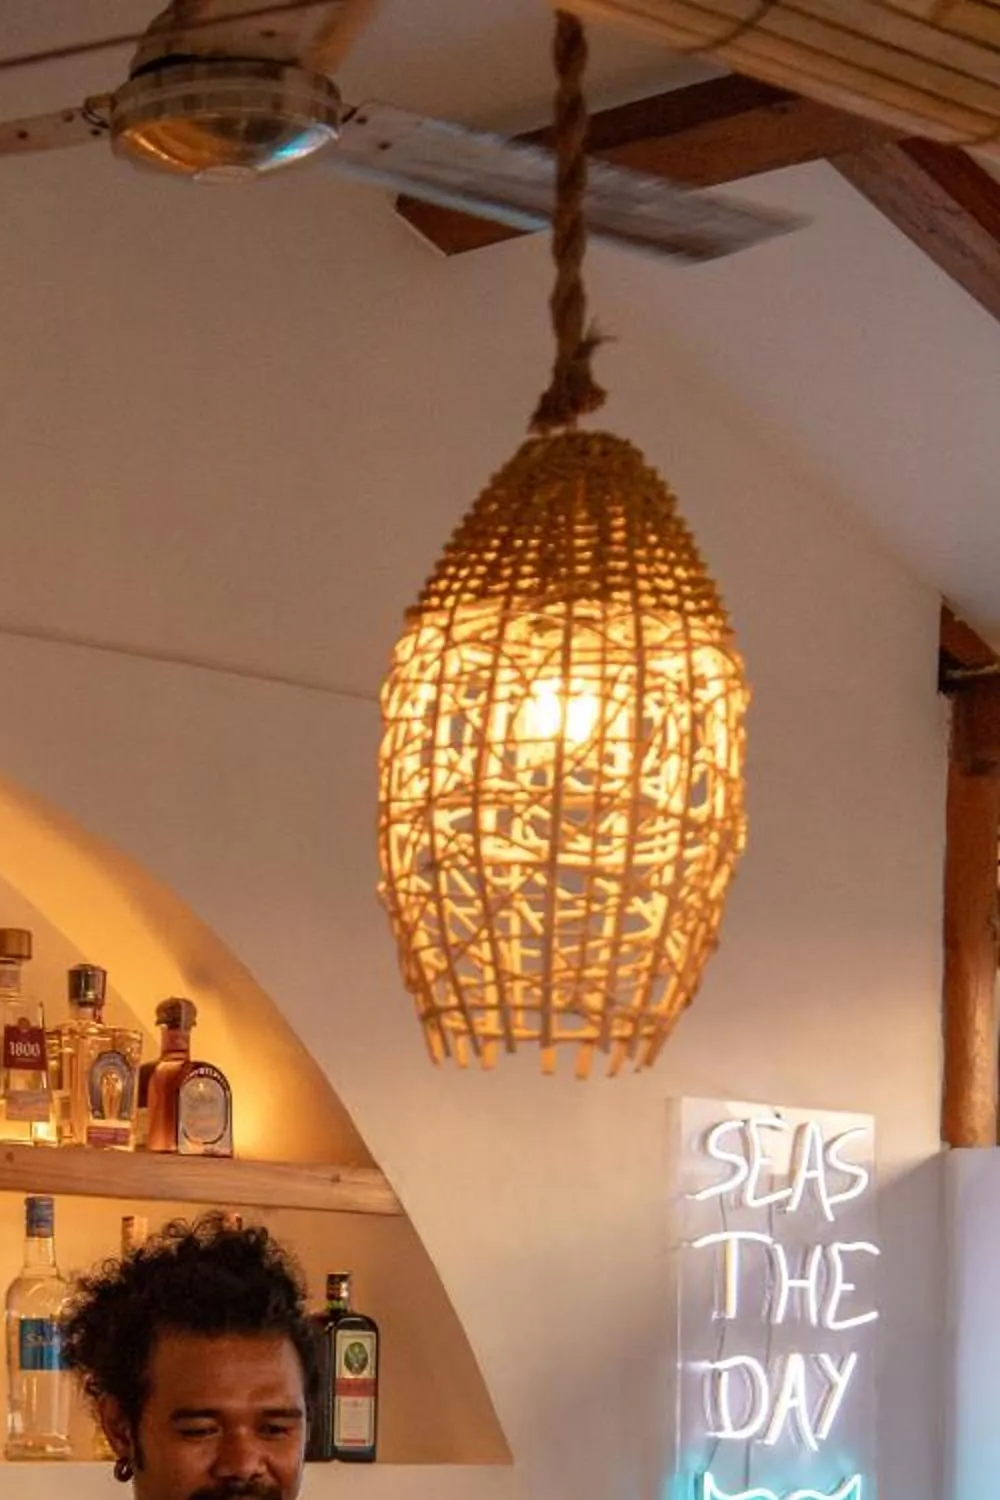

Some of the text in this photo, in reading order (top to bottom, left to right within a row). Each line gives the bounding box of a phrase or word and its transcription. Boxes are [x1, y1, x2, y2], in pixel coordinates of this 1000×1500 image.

[9, 1041, 41, 1057] 1800
[686, 1115, 868, 1221] SEAS
[691, 1230, 880, 1330] THE
[704, 1353, 858, 1451] DAY
